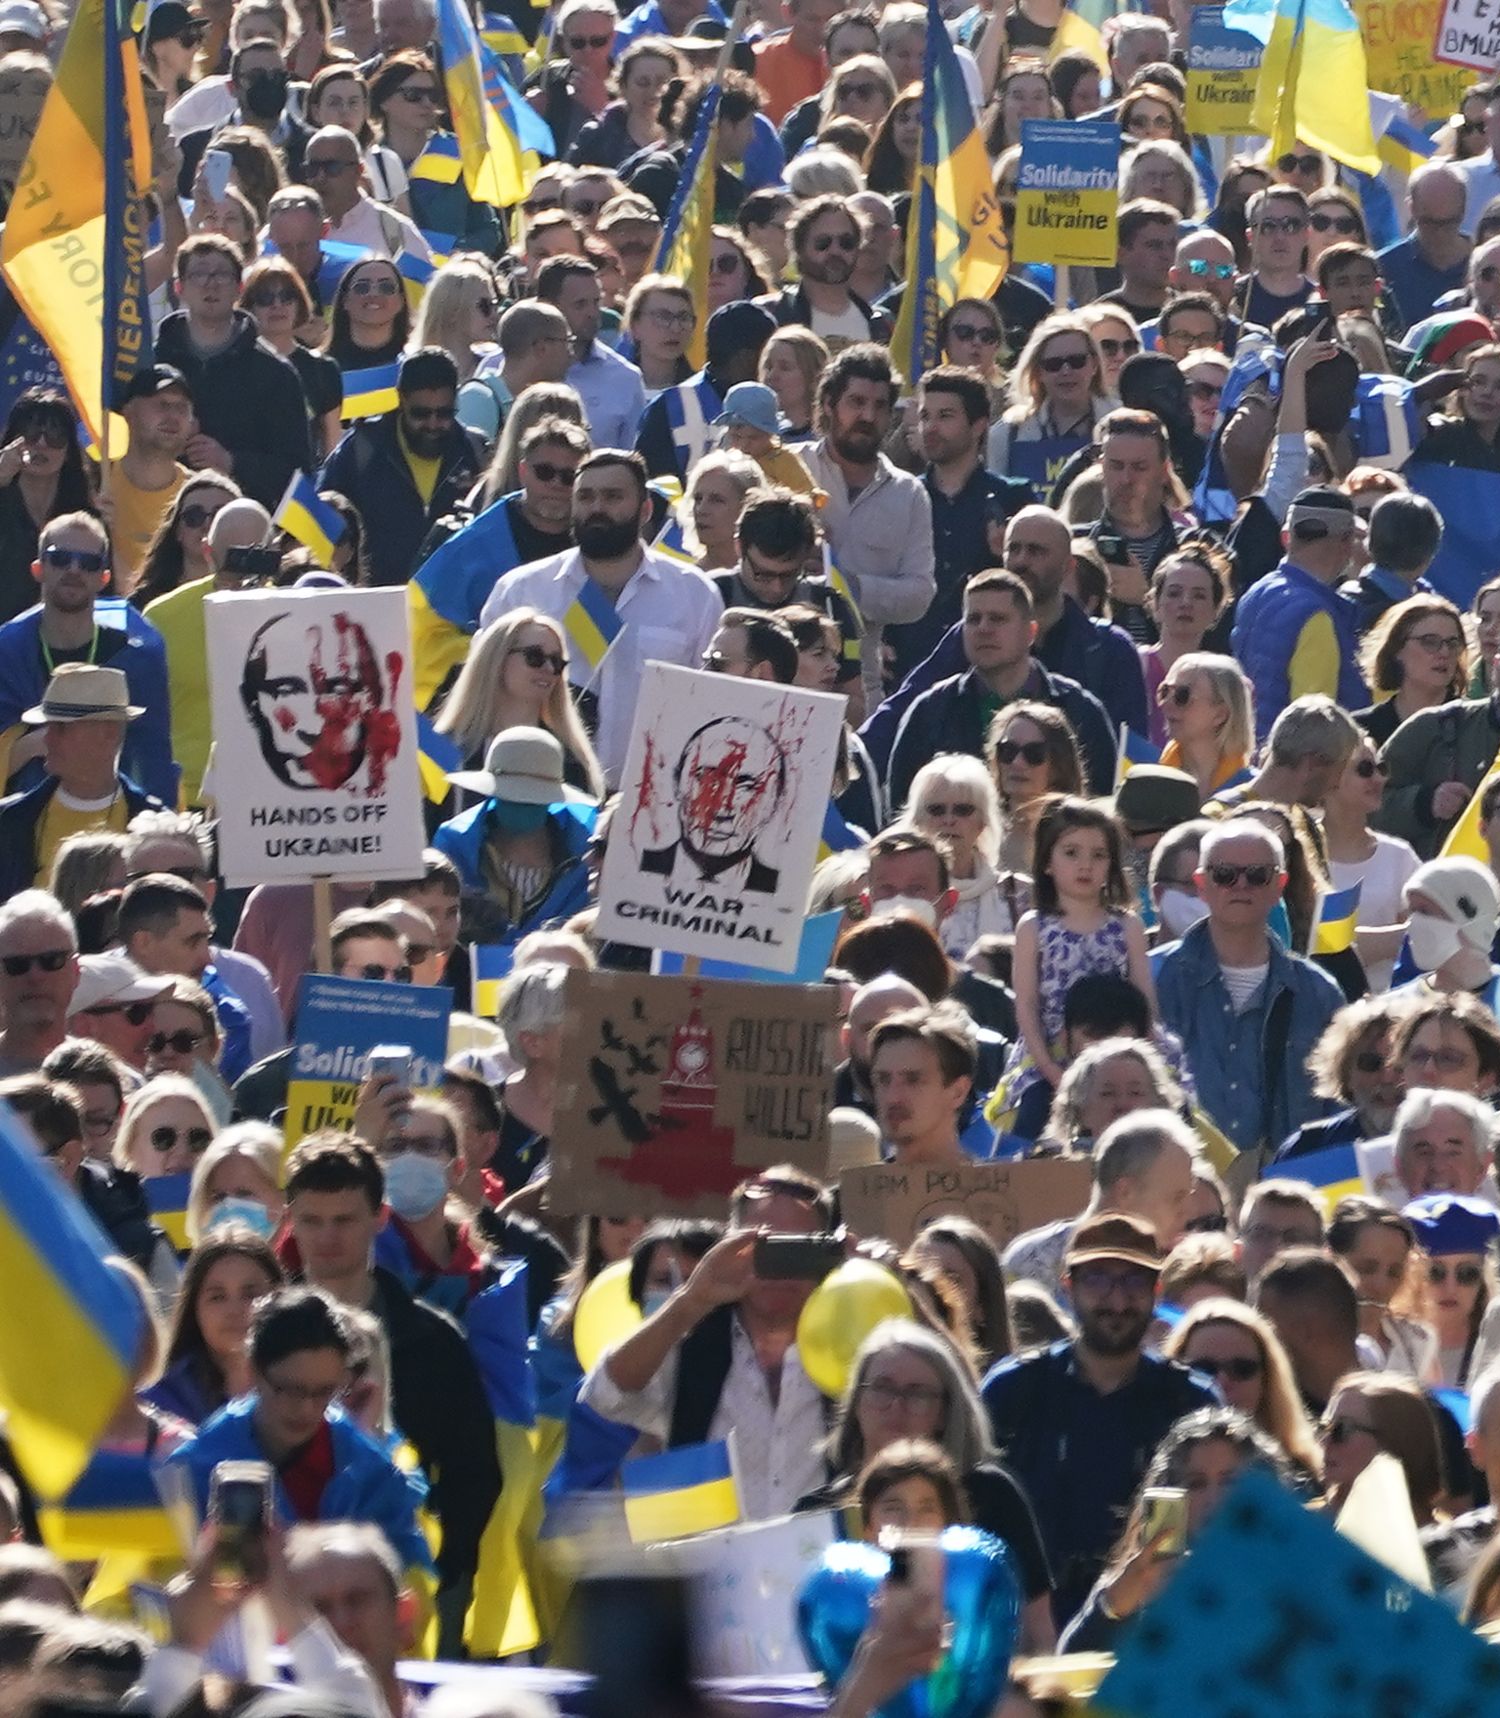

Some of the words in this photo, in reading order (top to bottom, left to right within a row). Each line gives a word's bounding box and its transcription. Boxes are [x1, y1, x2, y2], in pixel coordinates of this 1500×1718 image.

[1021, 163, 1118, 191] Solidarity
[1043, 191, 1080, 206] with
[1026, 205, 1108, 230] Ukraine
[250, 806, 337, 827] HANDS
[343, 804, 388, 823] OFF
[265, 835, 382, 858] UKRAINE!
[663, 887, 744, 917] WAR
[614, 900, 784, 947] CRIMINAL
